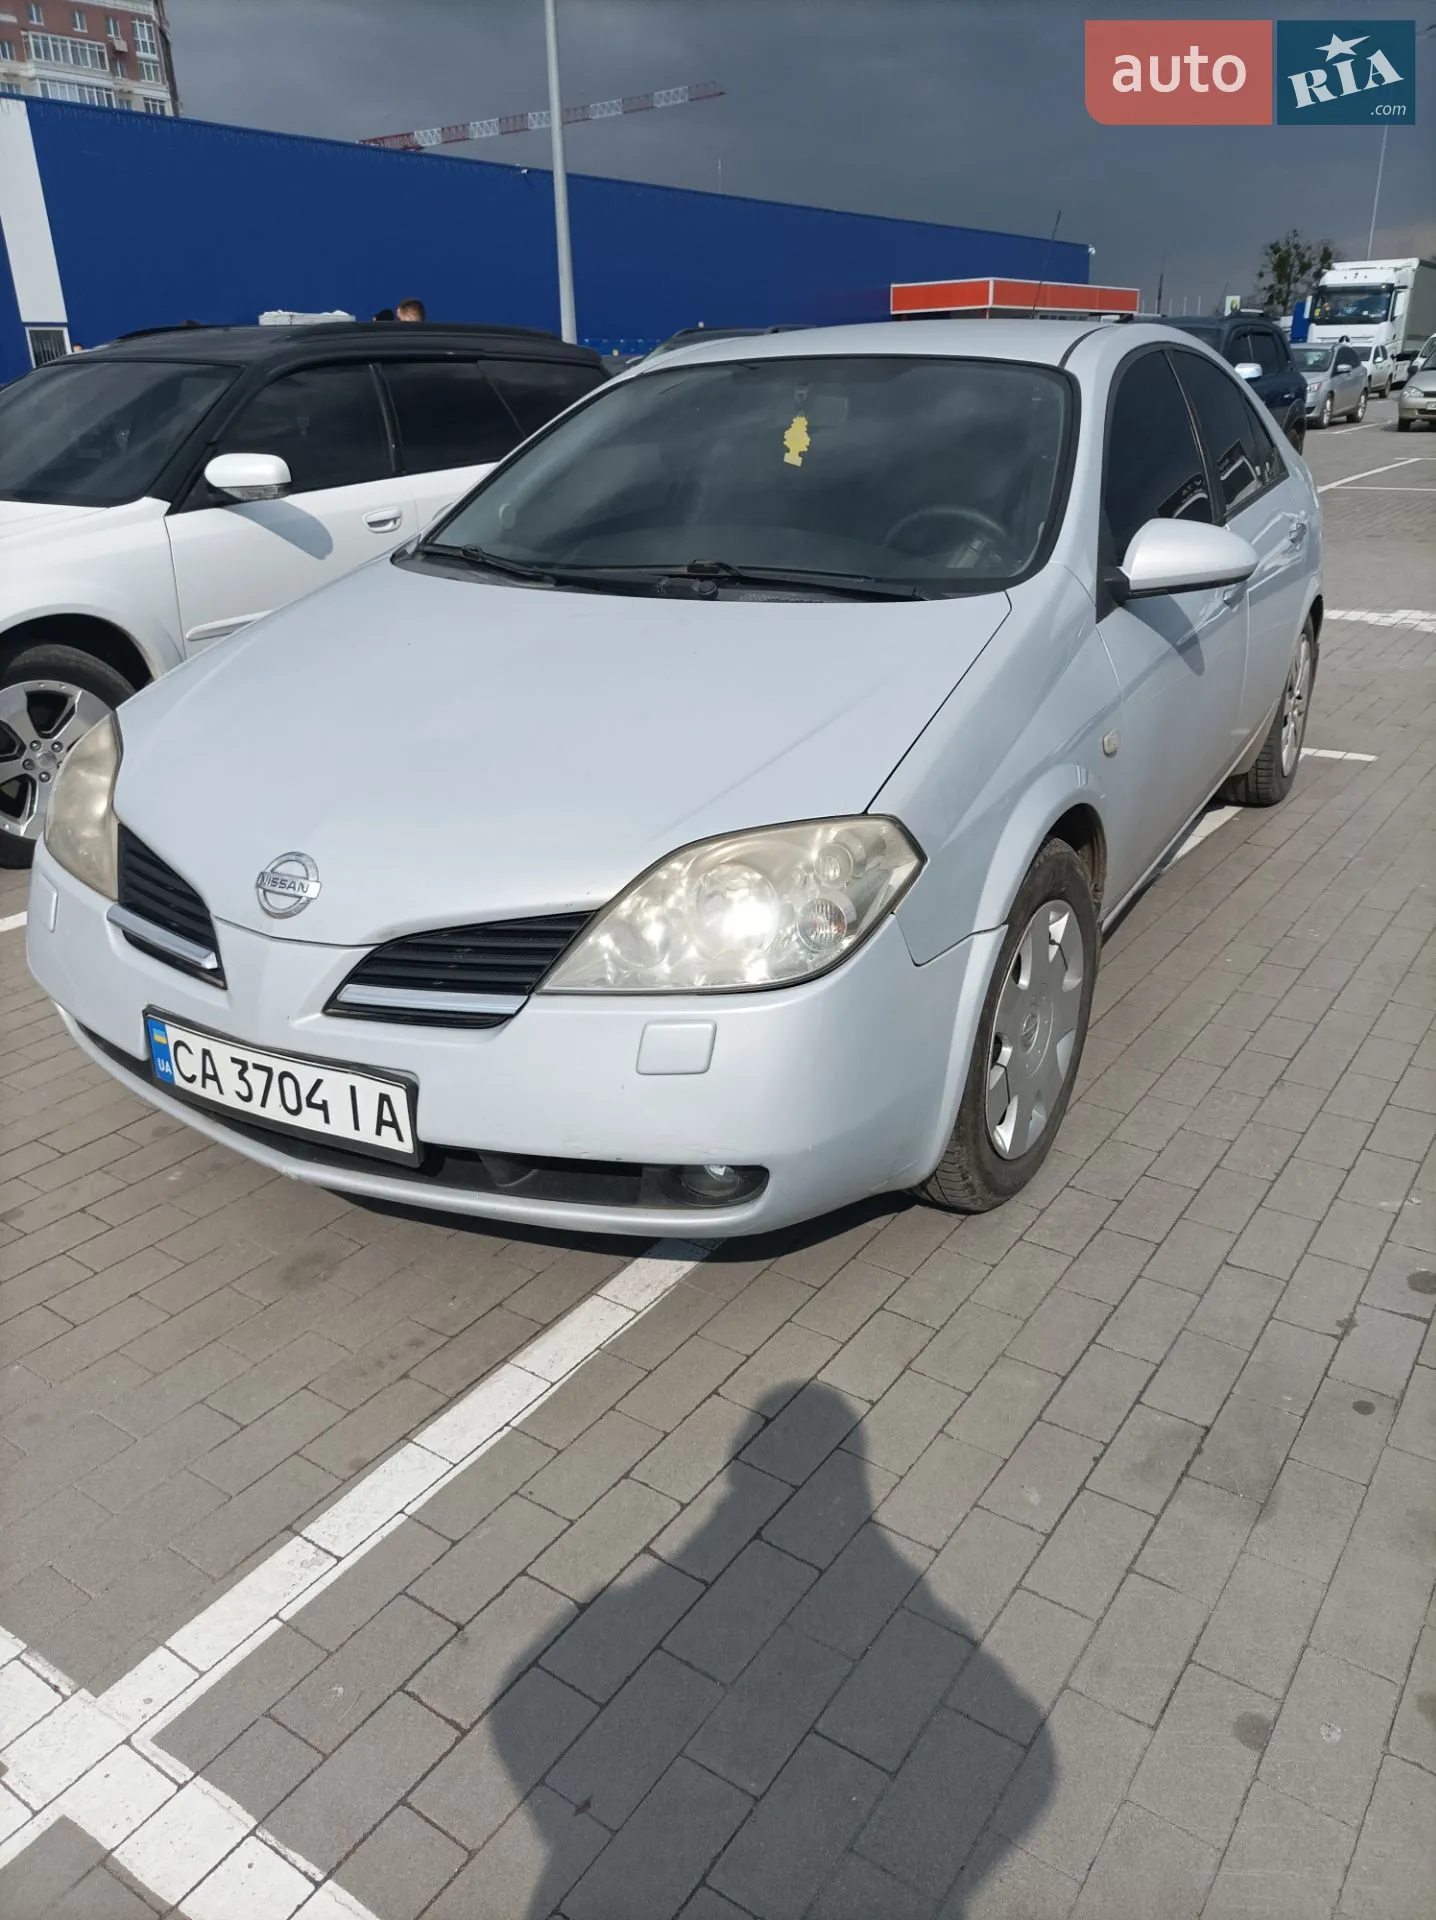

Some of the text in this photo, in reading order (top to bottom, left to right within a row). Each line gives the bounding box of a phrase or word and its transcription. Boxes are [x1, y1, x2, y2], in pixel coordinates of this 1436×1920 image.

[258, 872, 310, 894] NISSAN
[157, 1057, 173, 1075] UA
[173, 1040, 405, 1143] CA 3704 IA
